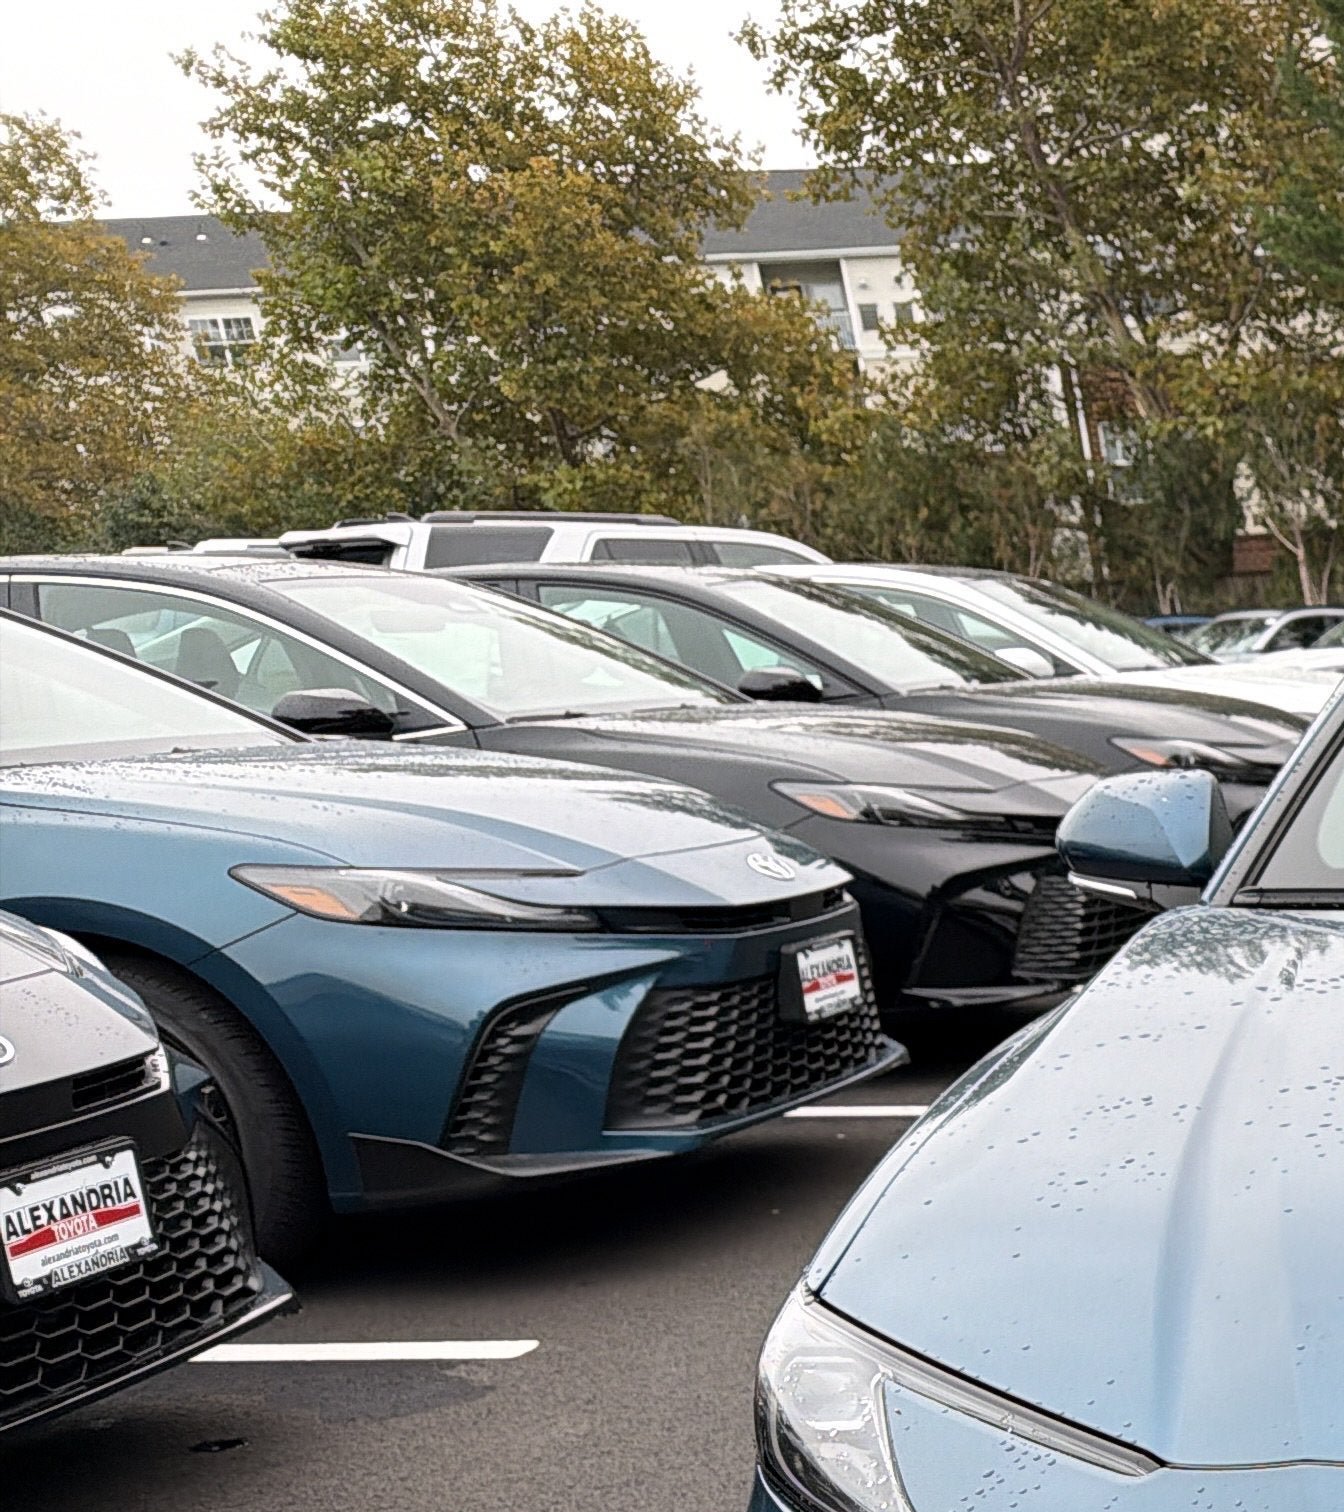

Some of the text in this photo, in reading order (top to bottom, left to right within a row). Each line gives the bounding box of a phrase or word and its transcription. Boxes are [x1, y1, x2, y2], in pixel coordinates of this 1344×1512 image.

[5, 1176, 137, 1242] ALEXANDRIA
[53, 1214, 98, 1242] TOYOTA
[40, 1233, 119, 1267] alexandriatoyota.com
[52, 1248, 128, 1286] ALEXANDRIA
